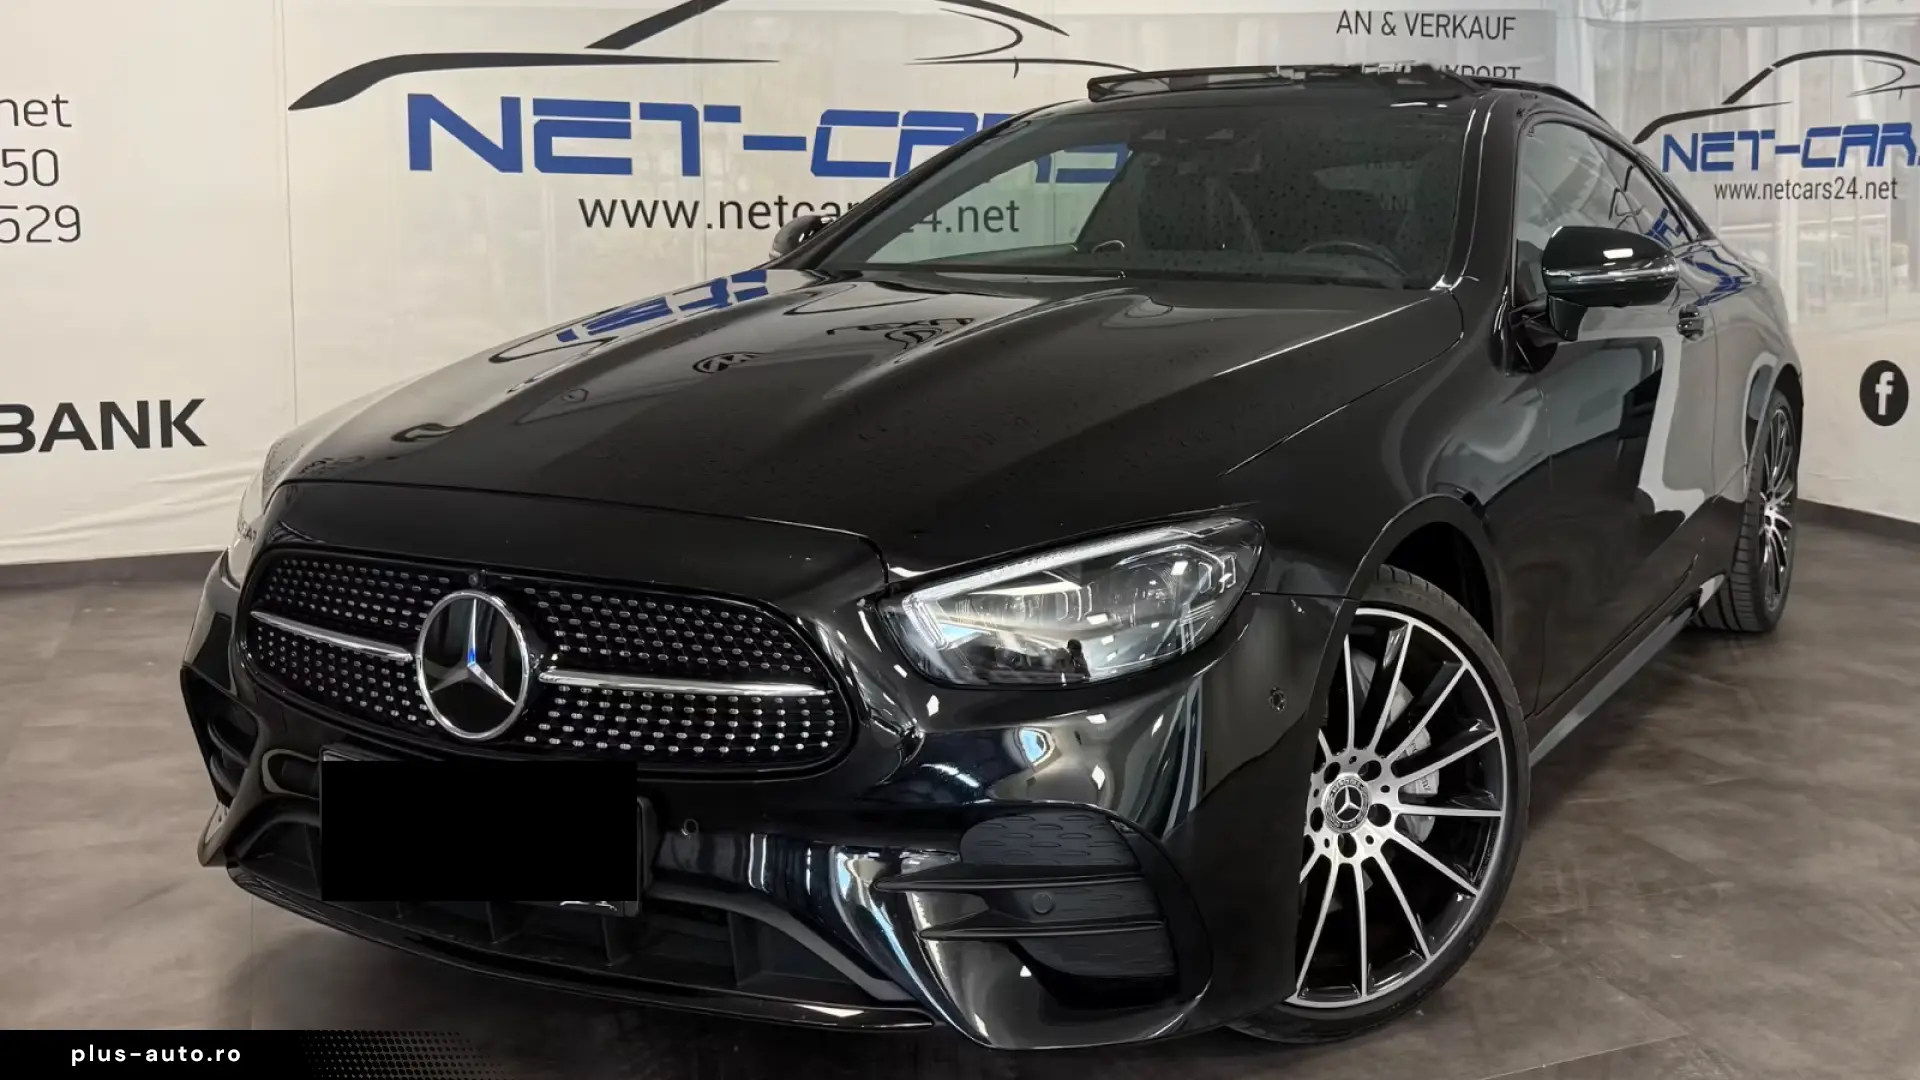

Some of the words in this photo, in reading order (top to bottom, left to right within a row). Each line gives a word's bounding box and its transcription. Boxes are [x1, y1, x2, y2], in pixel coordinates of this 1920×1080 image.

[1336, 10, 1372, 35] AN
[1381, 11, 1397, 36] &
[1404, 12, 1516, 40] VERKAUF
[1662, 122, 1920, 172] NET-CAR
[2, 148, 59, 187] 50
[1714, 176, 1898, 200] www.netcars24.net
